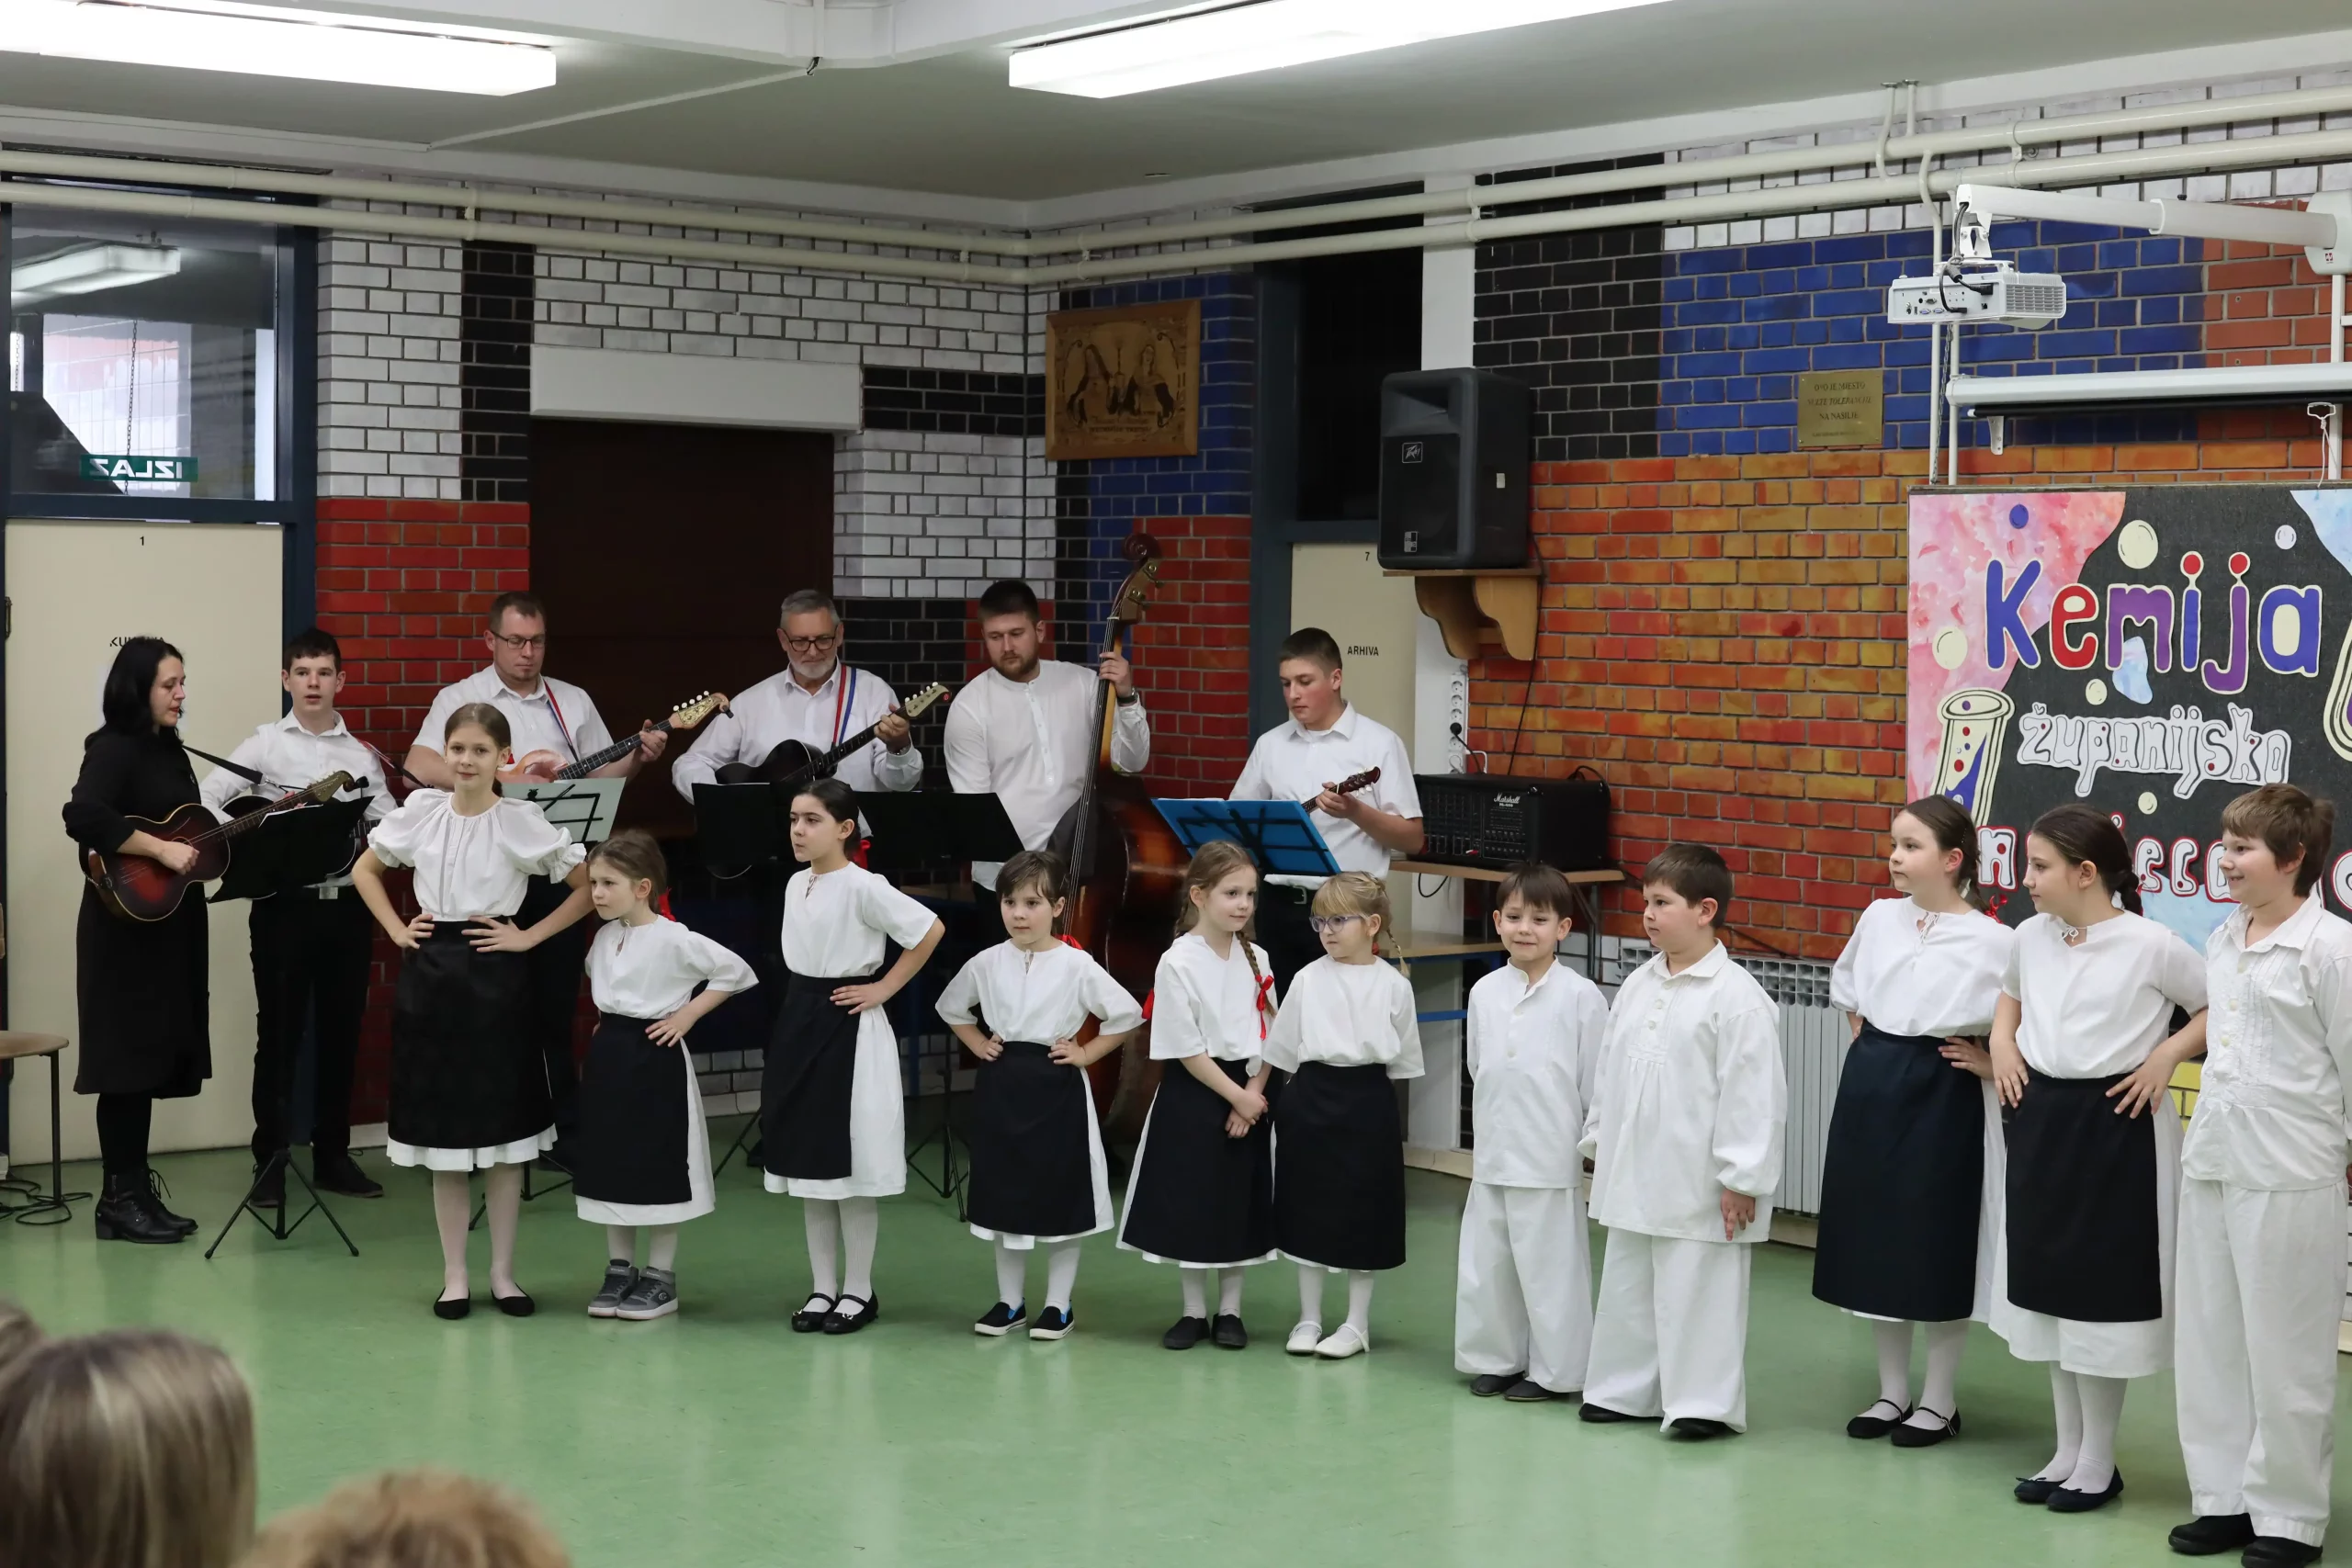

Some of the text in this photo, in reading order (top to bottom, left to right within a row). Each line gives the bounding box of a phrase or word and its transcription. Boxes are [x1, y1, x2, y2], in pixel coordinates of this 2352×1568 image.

[1819, 412, 1830, 421] NA
[140, 536, 145, 546] 1
[1364, 551, 1371, 561] 7
[1985, 551, 2323, 694] Kemija
[1347, 645, 1379, 656] ARHIVA
[1493, 792, 1521, 804] Marshall
